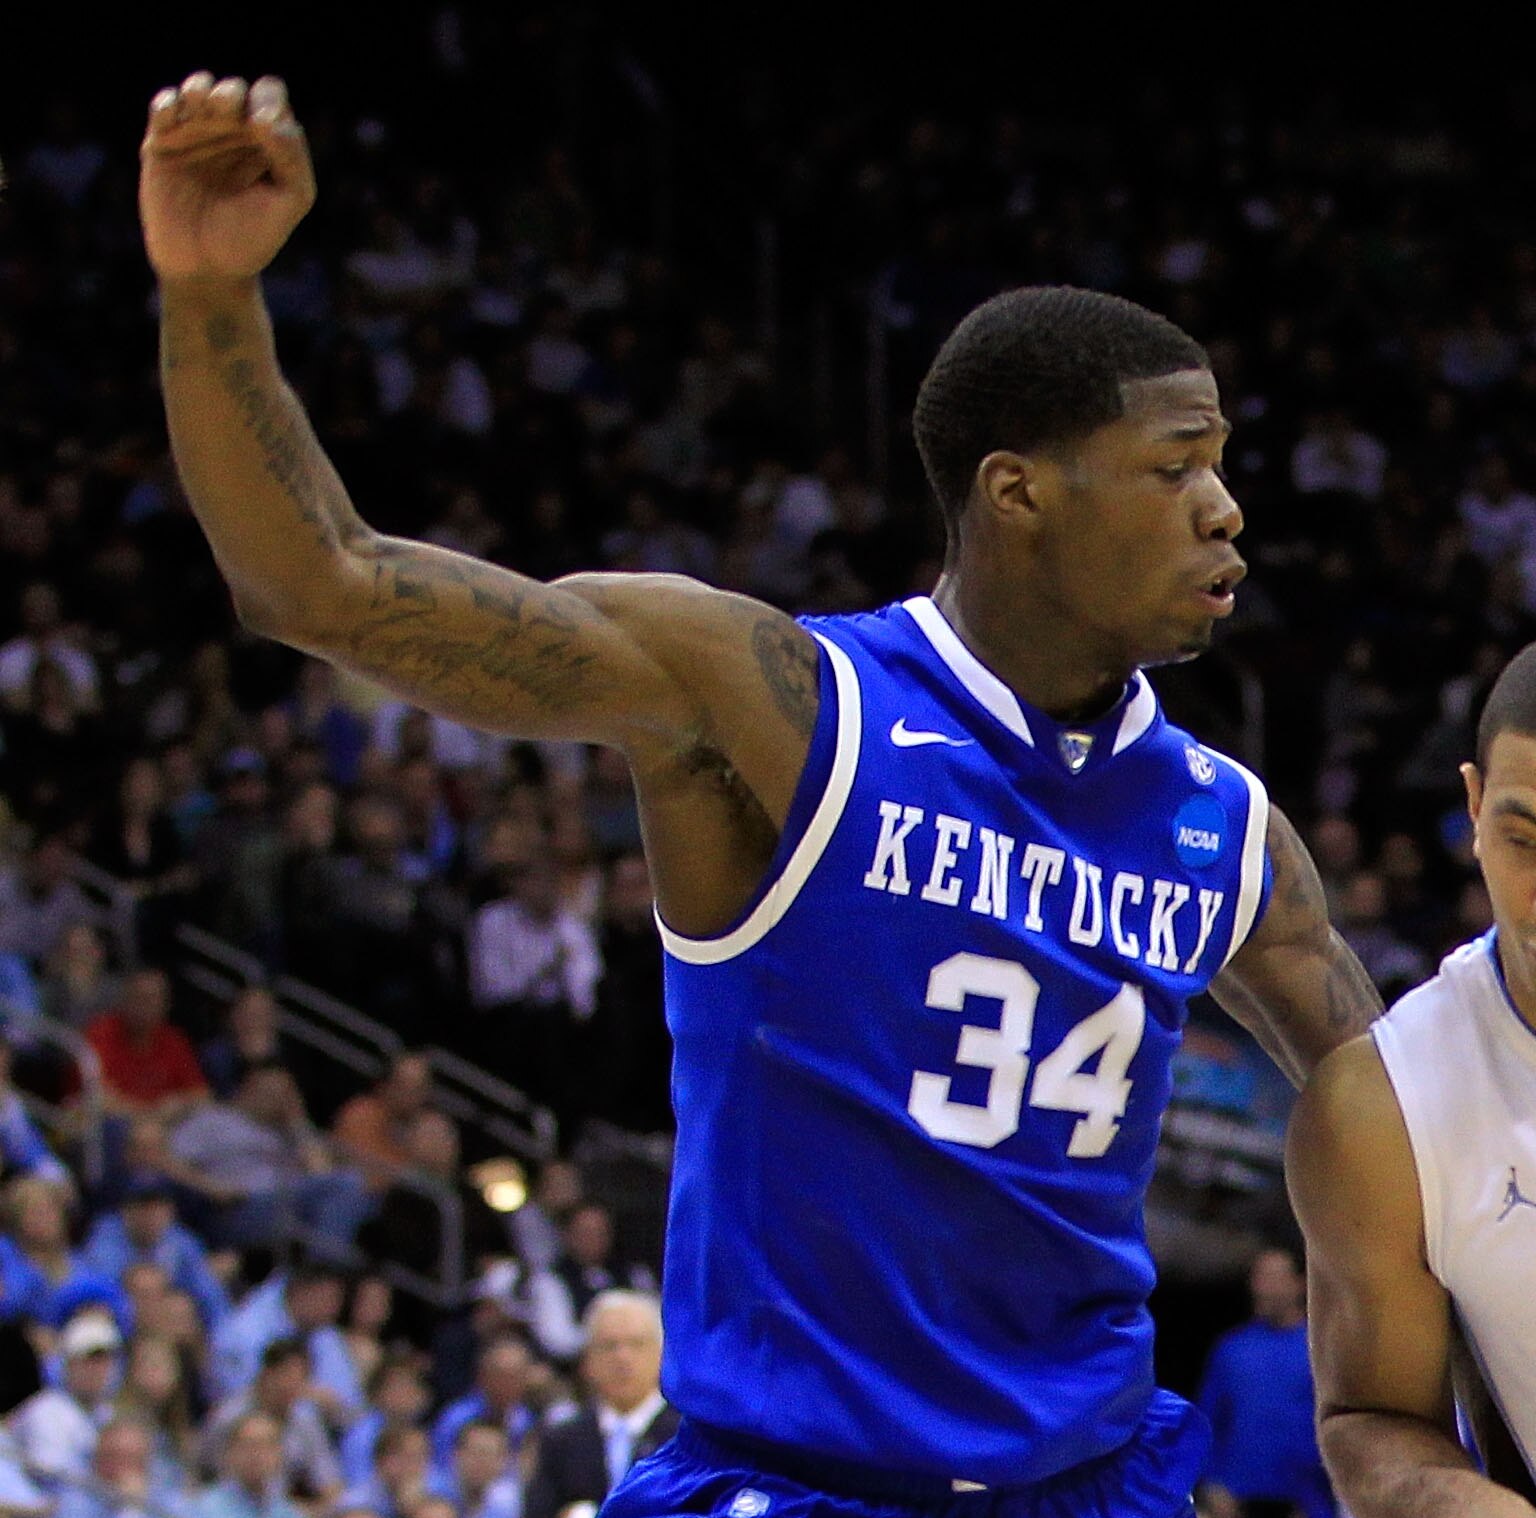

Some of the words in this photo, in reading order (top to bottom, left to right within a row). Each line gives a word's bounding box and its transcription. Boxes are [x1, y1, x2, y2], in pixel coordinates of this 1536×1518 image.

[863, 800, 1224, 975] KENTUCKY
[1177, 825, 1220, 853] NCAA
[907, 951, 1146, 1159] 34
